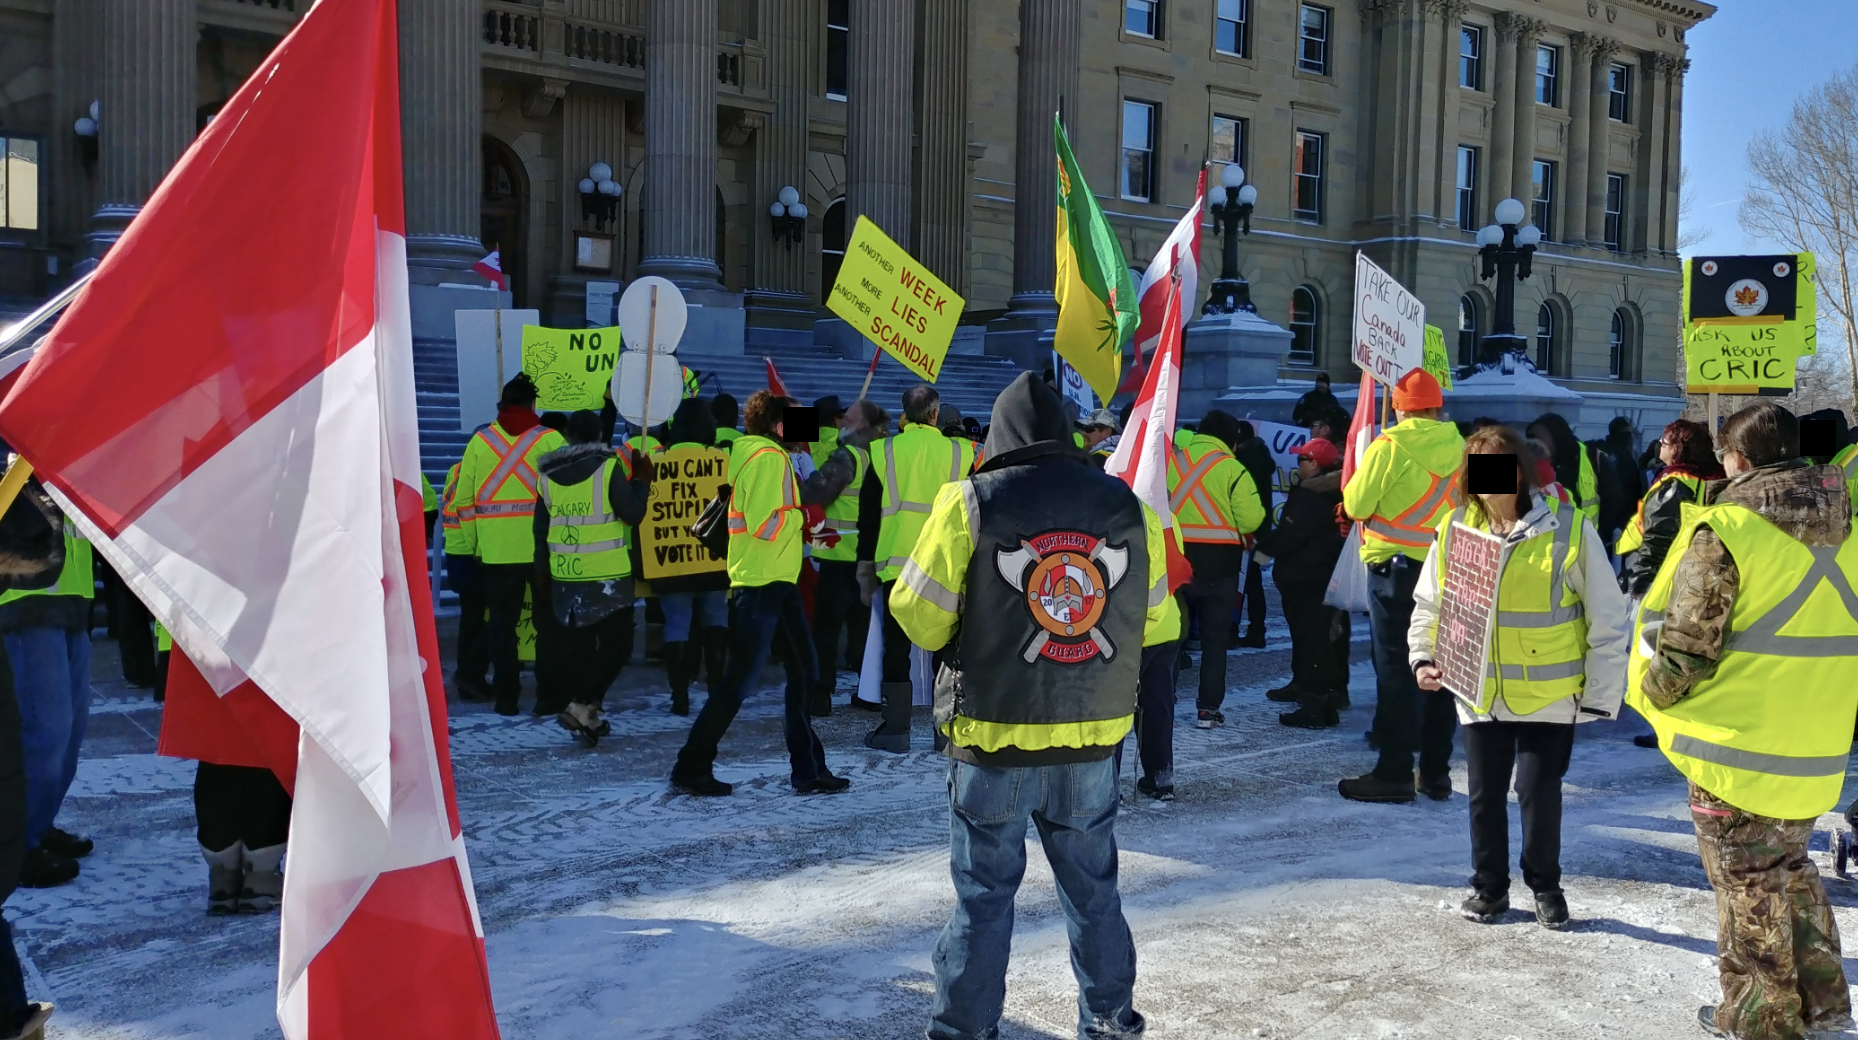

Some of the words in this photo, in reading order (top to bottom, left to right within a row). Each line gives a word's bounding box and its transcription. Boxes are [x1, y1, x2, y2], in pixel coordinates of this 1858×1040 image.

[858, 241, 895, 275] ANOTHER
[900, 266, 947, 317] WEEK
[1360, 256, 1393, 305] TAKE
[1396, 290, 1420, 329] OUR
[860, 277, 883, 300] MORE
[891, 296, 928, 334] LIES
[834, 283, 871, 316] ANOTHER
[870, 316, 936, 378] SCANDAL
[1361, 293, 1406, 348] Canada
[569, 332, 602, 351] NO
[1368, 326, 1398, 361] BACK
[1693, 329, 1731, 342] ASK
[1751, 327, 1778, 341] US
[1355, 338, 1374, 368] VOTE
[1375, 354, 1394, 379] OUT
[1721, 344, 1776, 357] ABOUT
[585, 353, 615, 373] UN
[1700, 358, 1785, 381] CRIC
[1064, 363, 1081, 387] NO
[653, 461, 679, 482] YOU
[684, 456, 724, 478] CAN'T
[671, 482, 698, 500] FIX
[551, 501, 591, 518] CALGARY
[654, 526, 679, 540] BUT
[1035, 534, 1091, 552] NORTHERN
[654, 544, 692, 567] VOTE
[696, 544, 705, 562] IT
[1043, 598, 1053, 607] 20
[1047, 643, 1094, 659] GUARD
